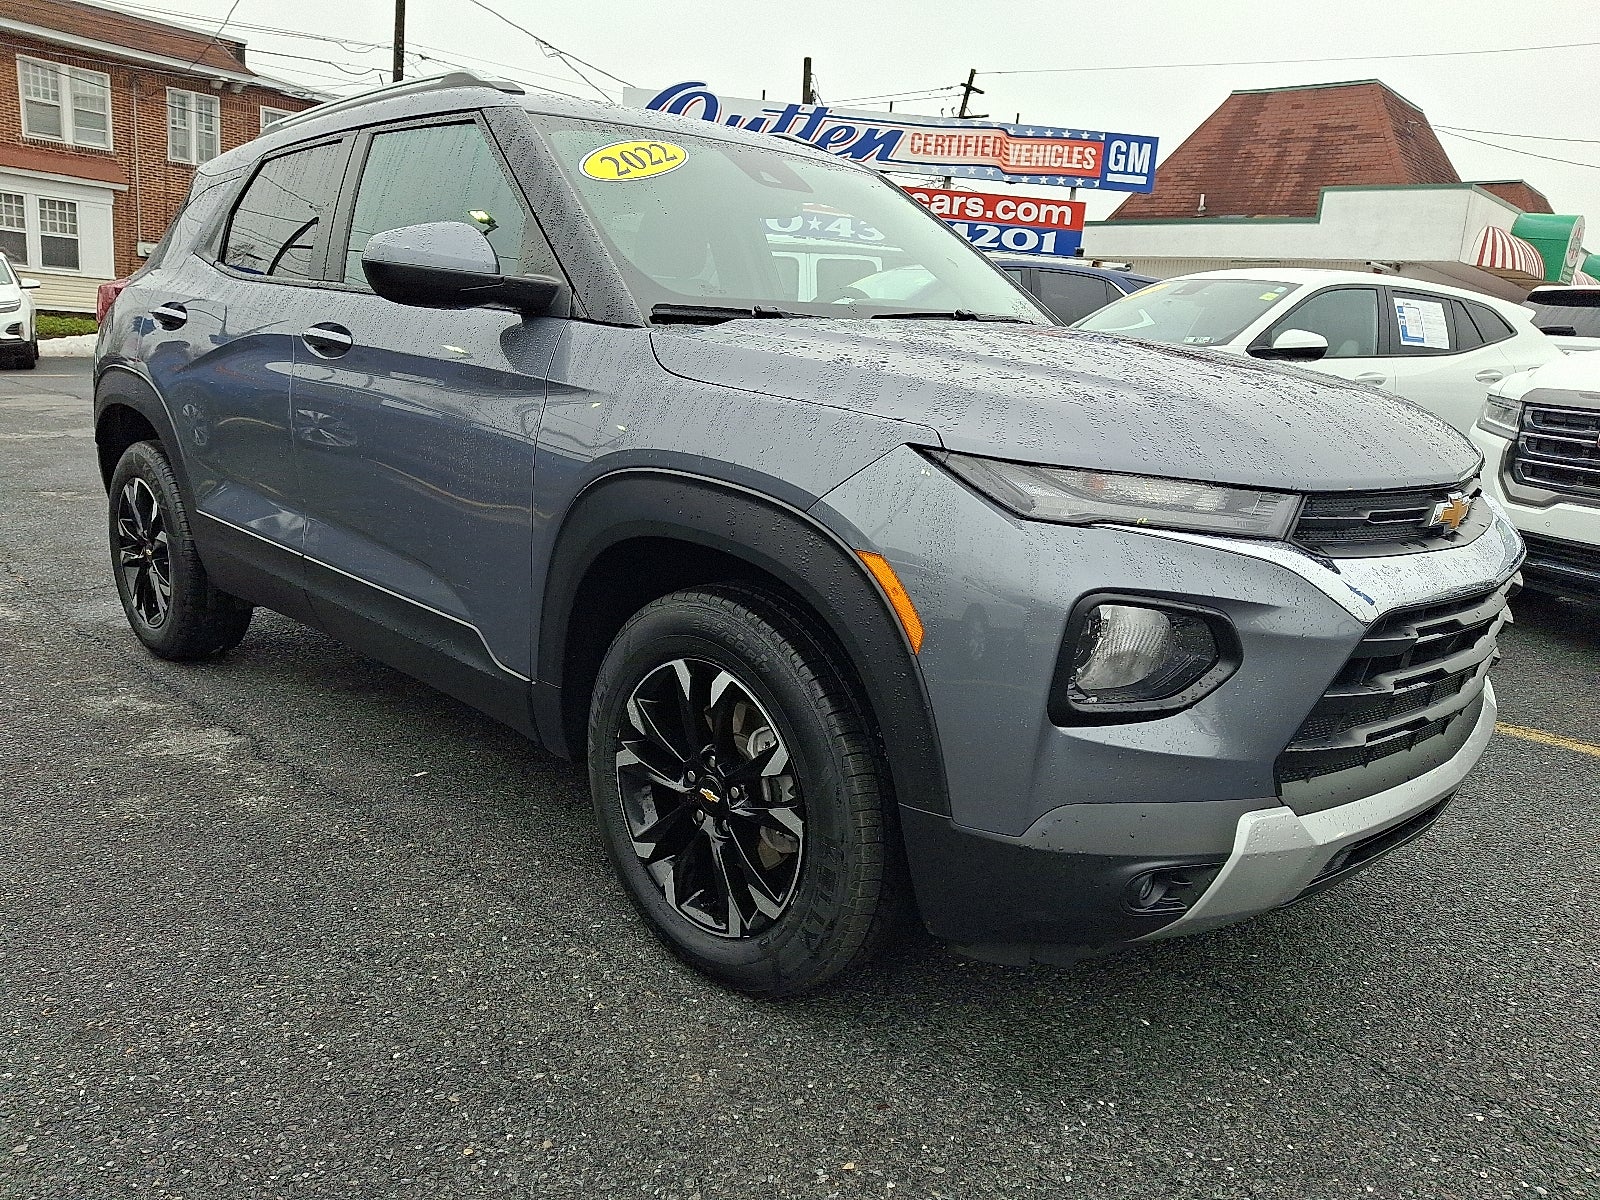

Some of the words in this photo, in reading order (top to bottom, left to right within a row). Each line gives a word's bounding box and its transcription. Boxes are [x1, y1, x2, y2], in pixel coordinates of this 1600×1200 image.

[600, 143, 678, 177] 2022
[910, 132, 1001, 158] CERTIFIED
[1008, 143, 1096, 170] VEHICLES
[1108, 139, 1152, 175] GM
